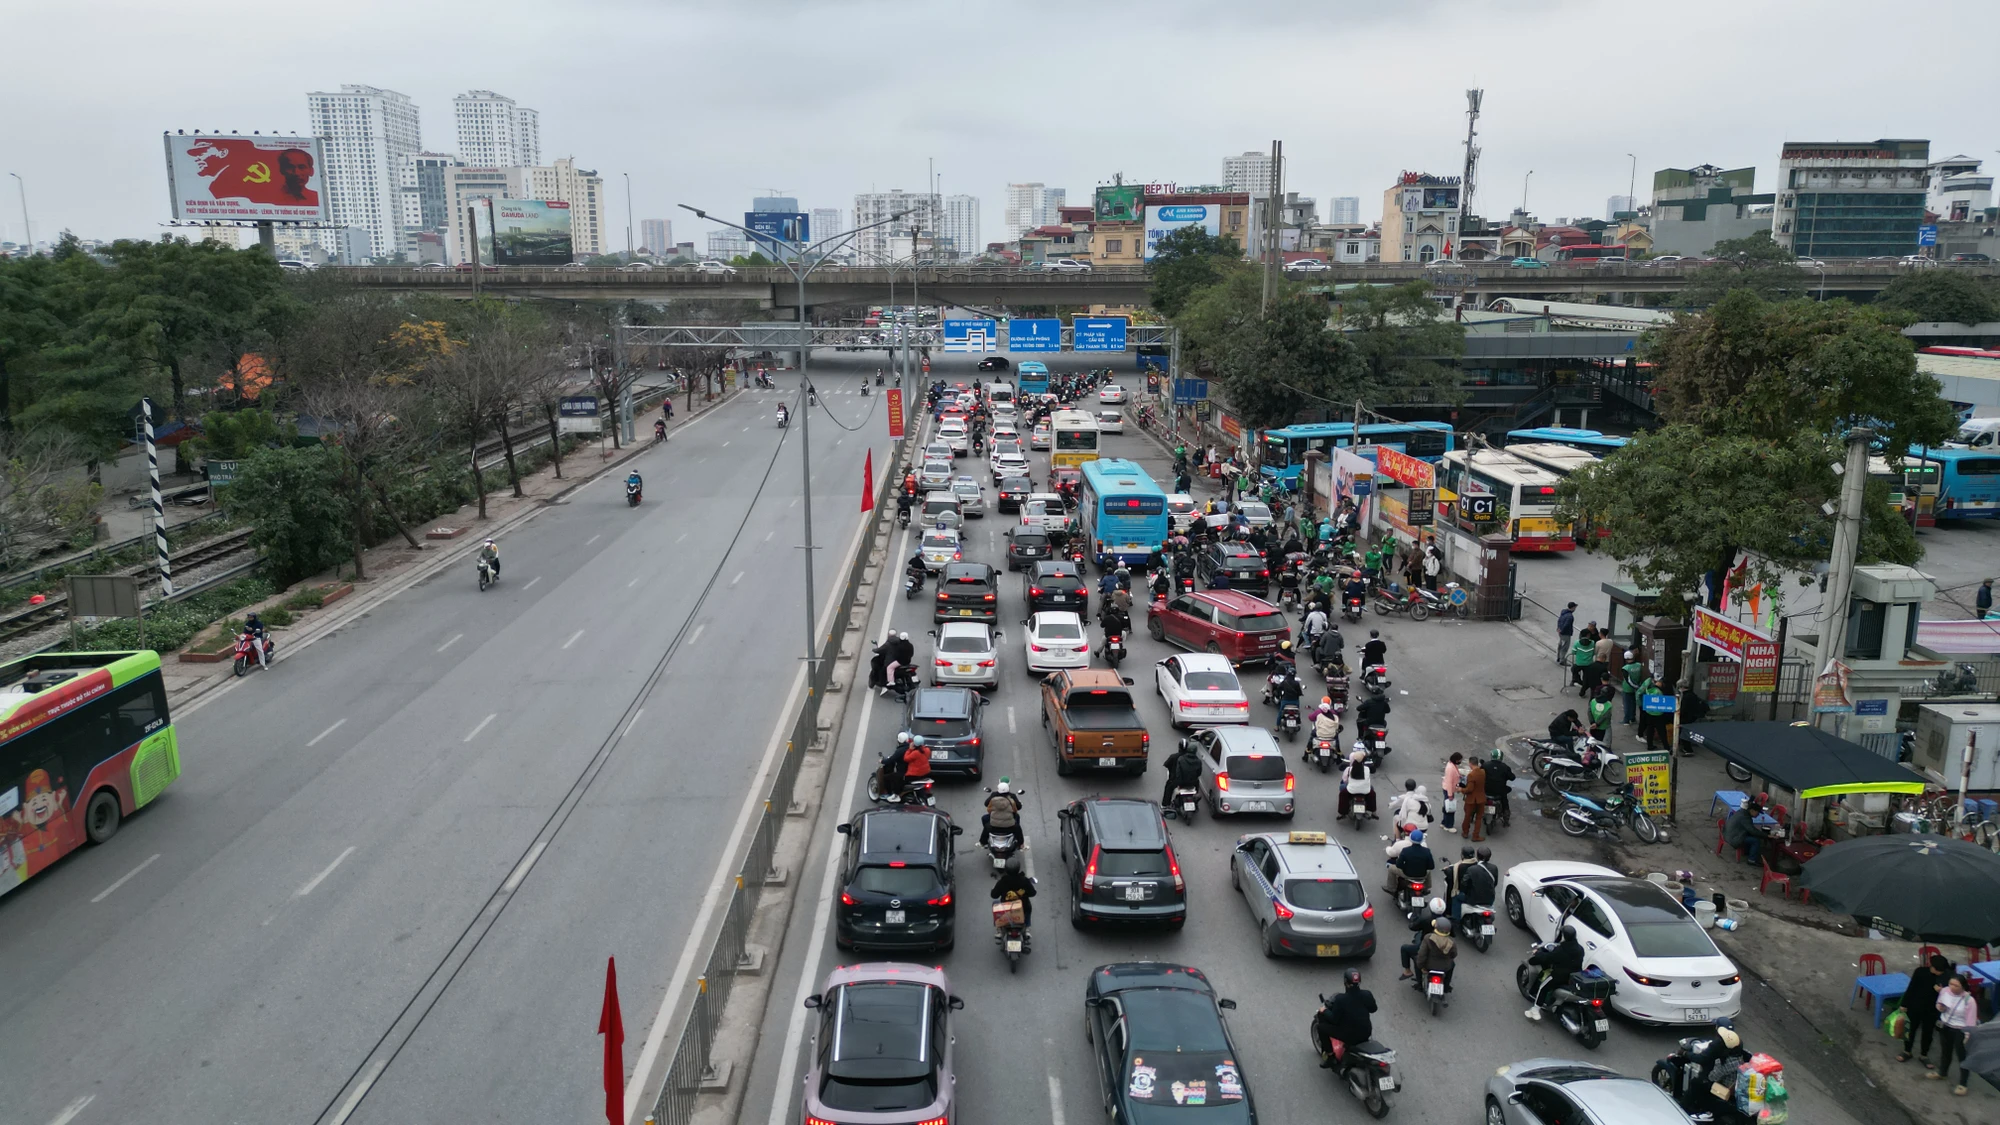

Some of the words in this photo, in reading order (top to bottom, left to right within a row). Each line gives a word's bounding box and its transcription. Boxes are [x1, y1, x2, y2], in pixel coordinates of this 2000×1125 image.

[1145, 180, 1161, 194] BẾP
[1164, 181, 1176, 194] TỪ
[1461, 496, 1469, 511] C1
[1474, 500, 1492, 512] C1
[1749, 645, 1775, 655] NHÀ
[1746, 655, 1777, 667] NGHỈ
[1712, 664, 1735, 673] NHÀ
[1628, 756, 1650, 764] CƯỜNG
[1628, 765, 1644, 773] NHÀ
[1633, 787, 1644, 797] ÚN
